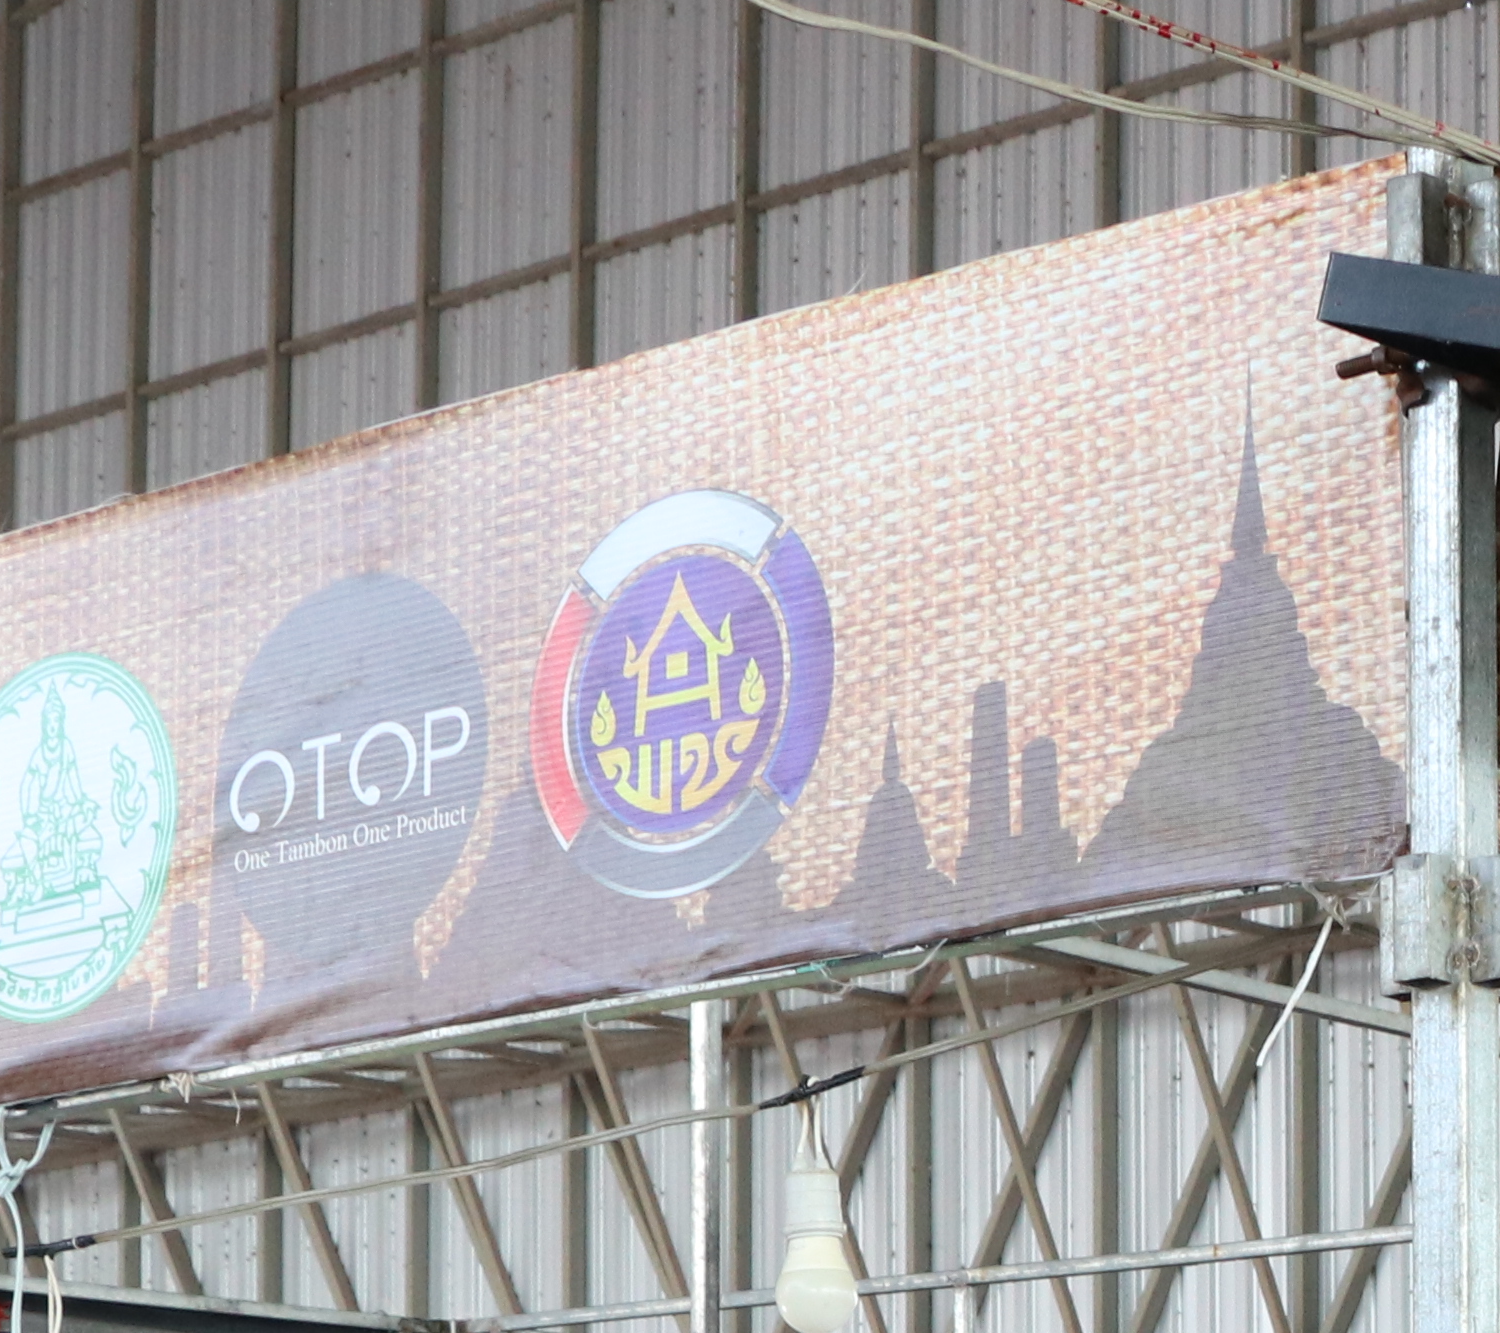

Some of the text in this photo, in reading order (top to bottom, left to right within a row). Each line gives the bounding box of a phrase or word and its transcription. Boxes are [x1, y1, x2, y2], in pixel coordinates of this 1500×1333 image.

[229, 705, 471, 834] OTOP
[233, 804, 468, 874] One Tambon One Product
